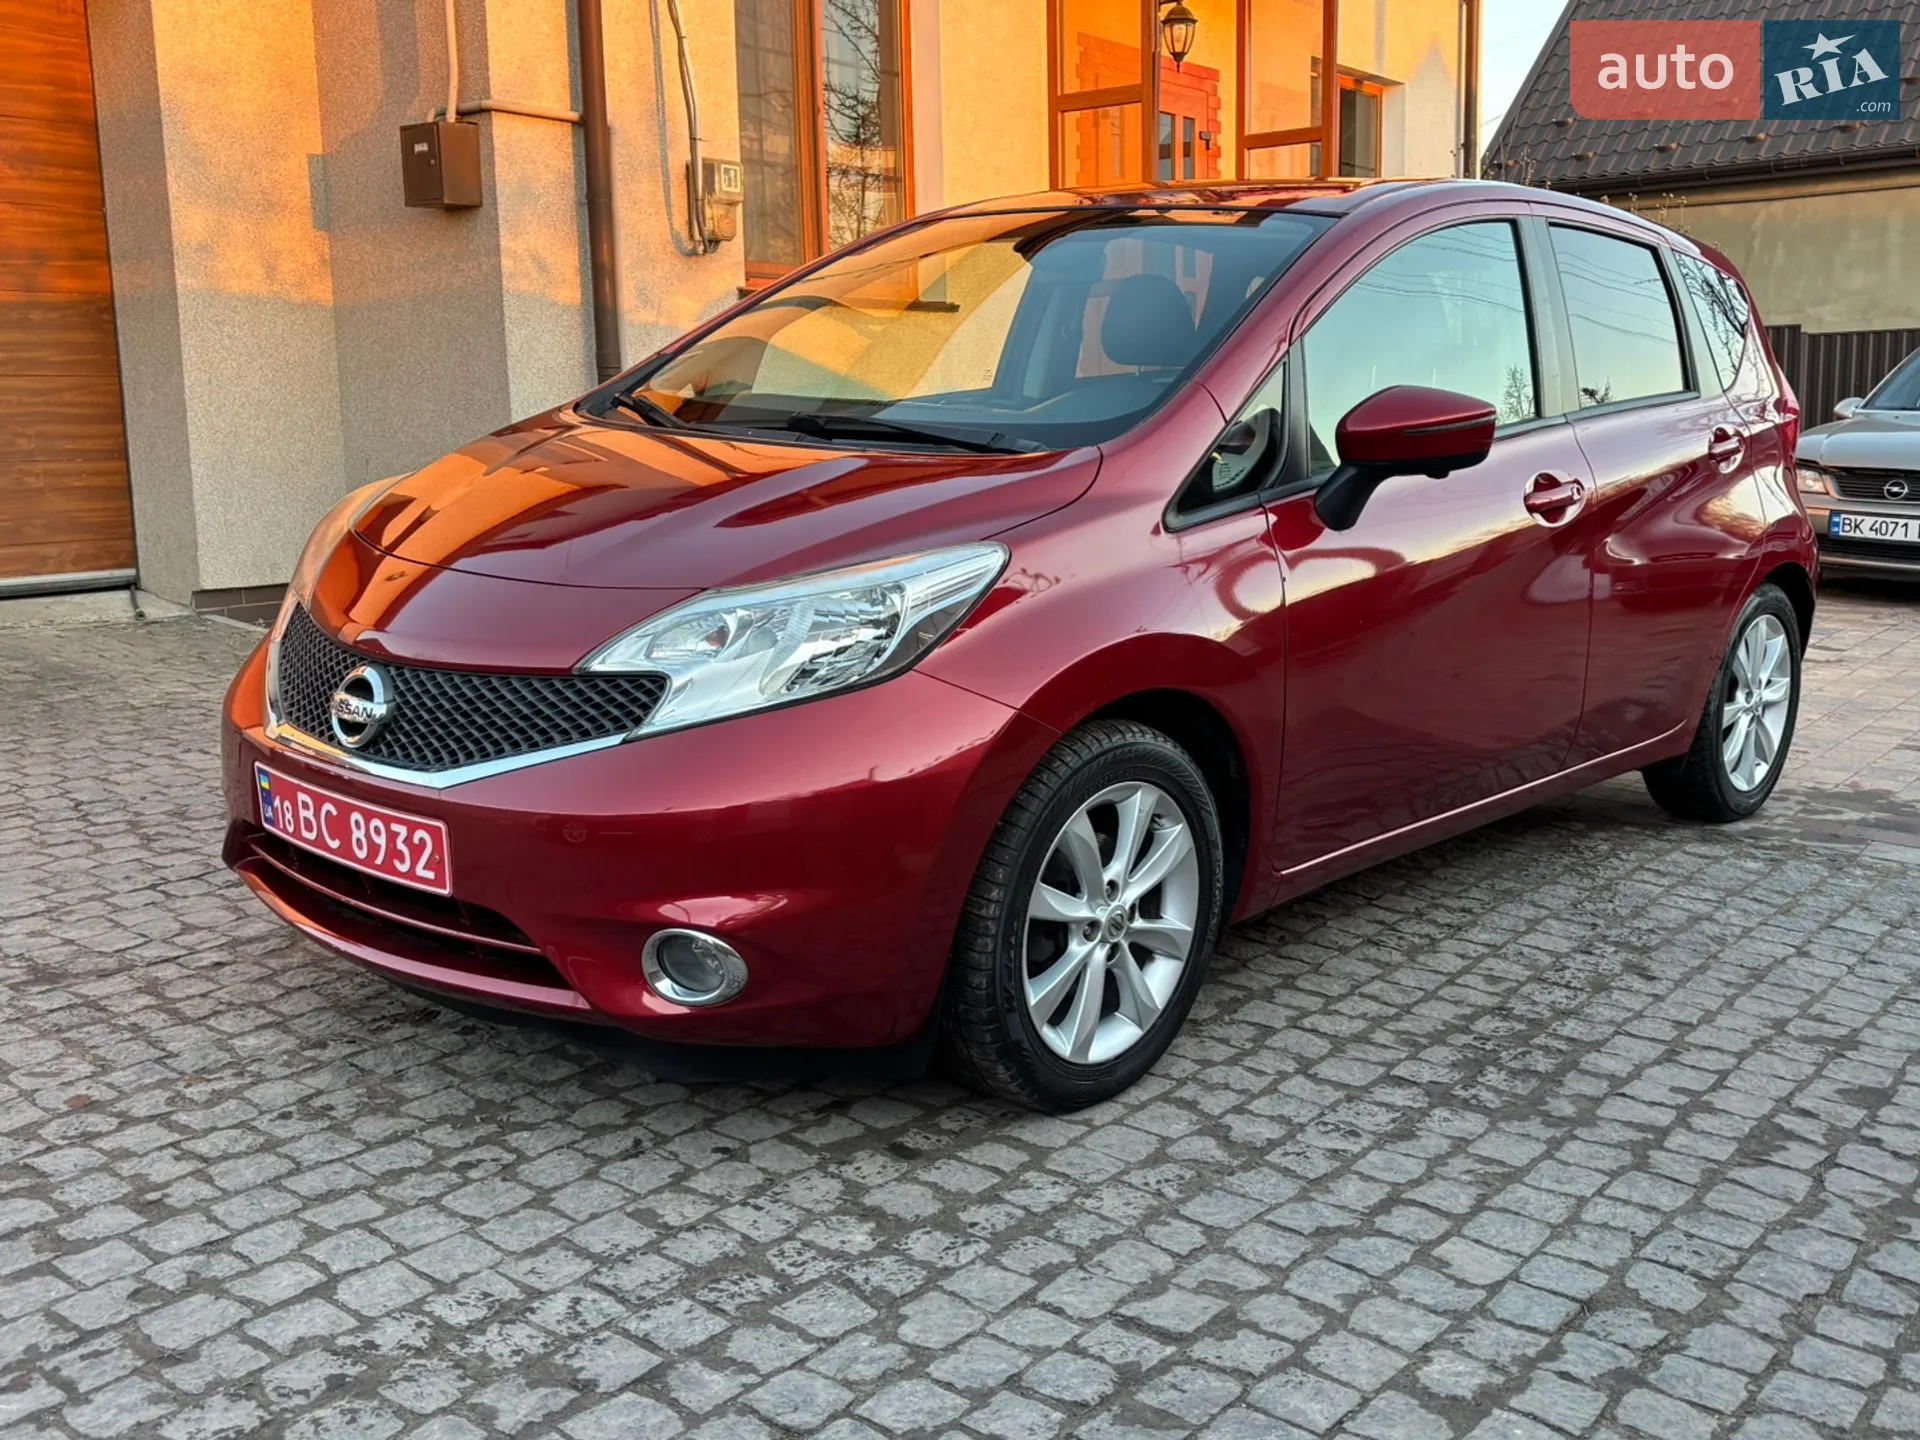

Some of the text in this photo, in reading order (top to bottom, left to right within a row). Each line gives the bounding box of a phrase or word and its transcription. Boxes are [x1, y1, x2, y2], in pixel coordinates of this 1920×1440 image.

[1841, 517, 1866, 535] BK
[1869, 519, 1909, 539] 4071
[273, 791, 435, 880] 18 BC 8932
